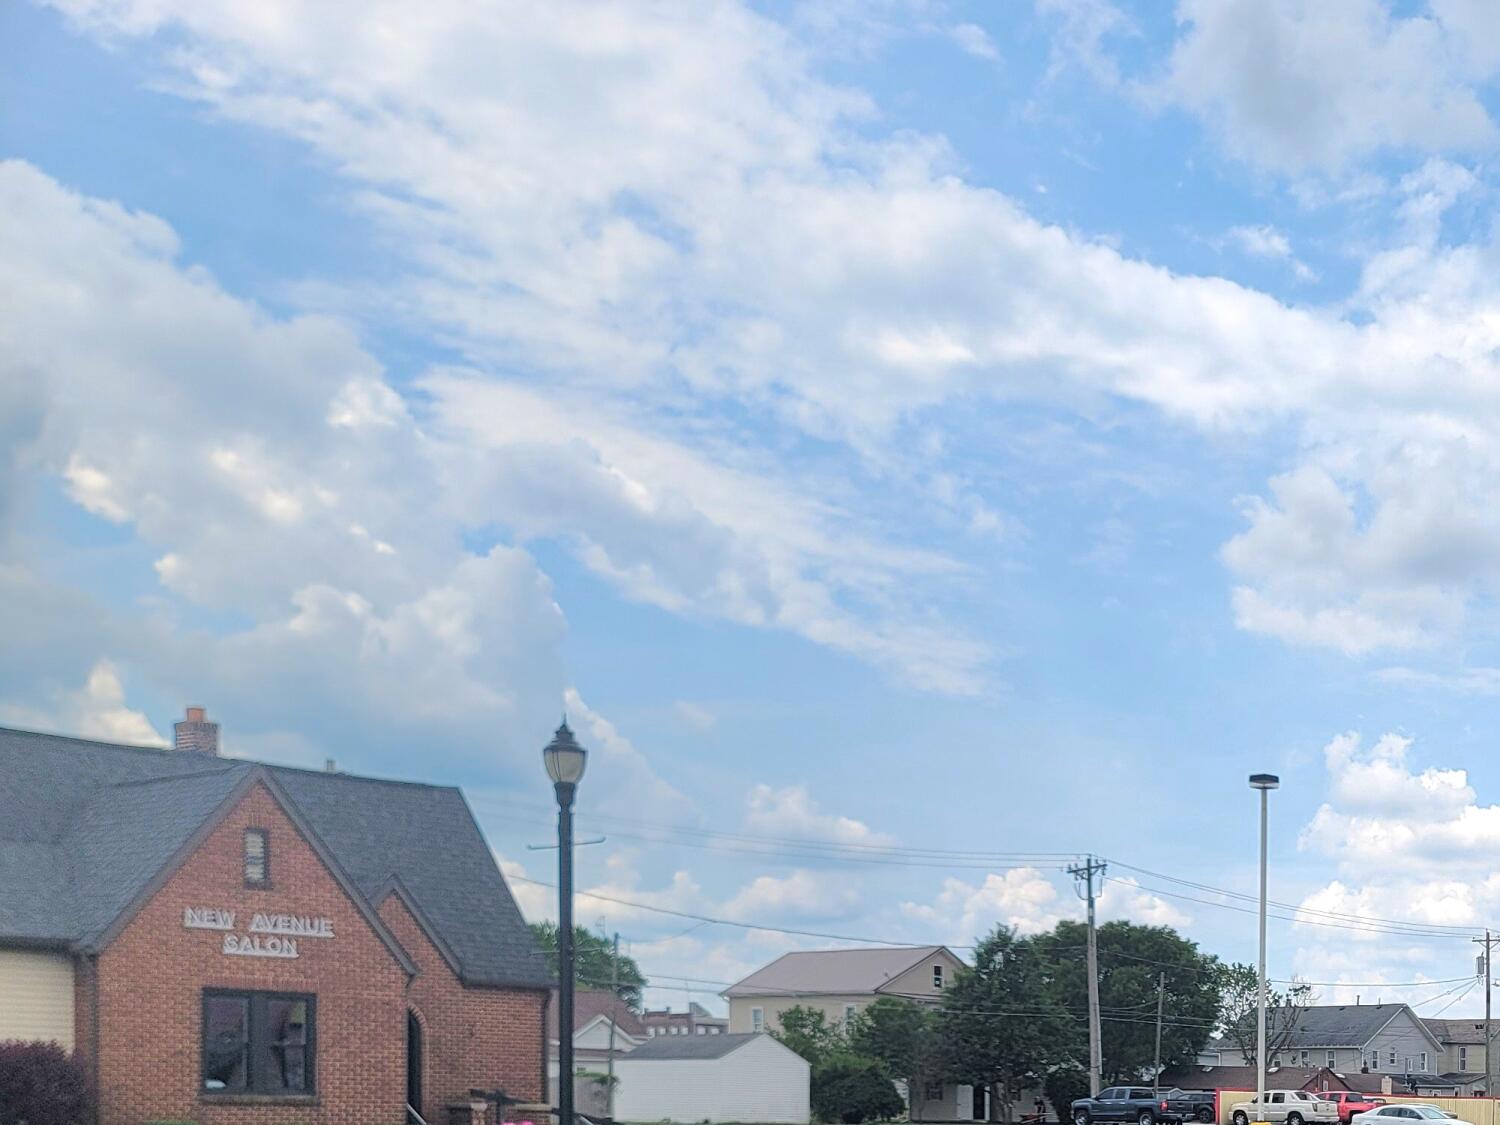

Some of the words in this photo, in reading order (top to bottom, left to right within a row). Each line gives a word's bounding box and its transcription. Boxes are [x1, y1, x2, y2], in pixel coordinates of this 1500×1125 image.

[184, 906, 236, 930] NEW
[250, 911, 336, 938] AVENUE
[223, 933, 299, 958] SALON
